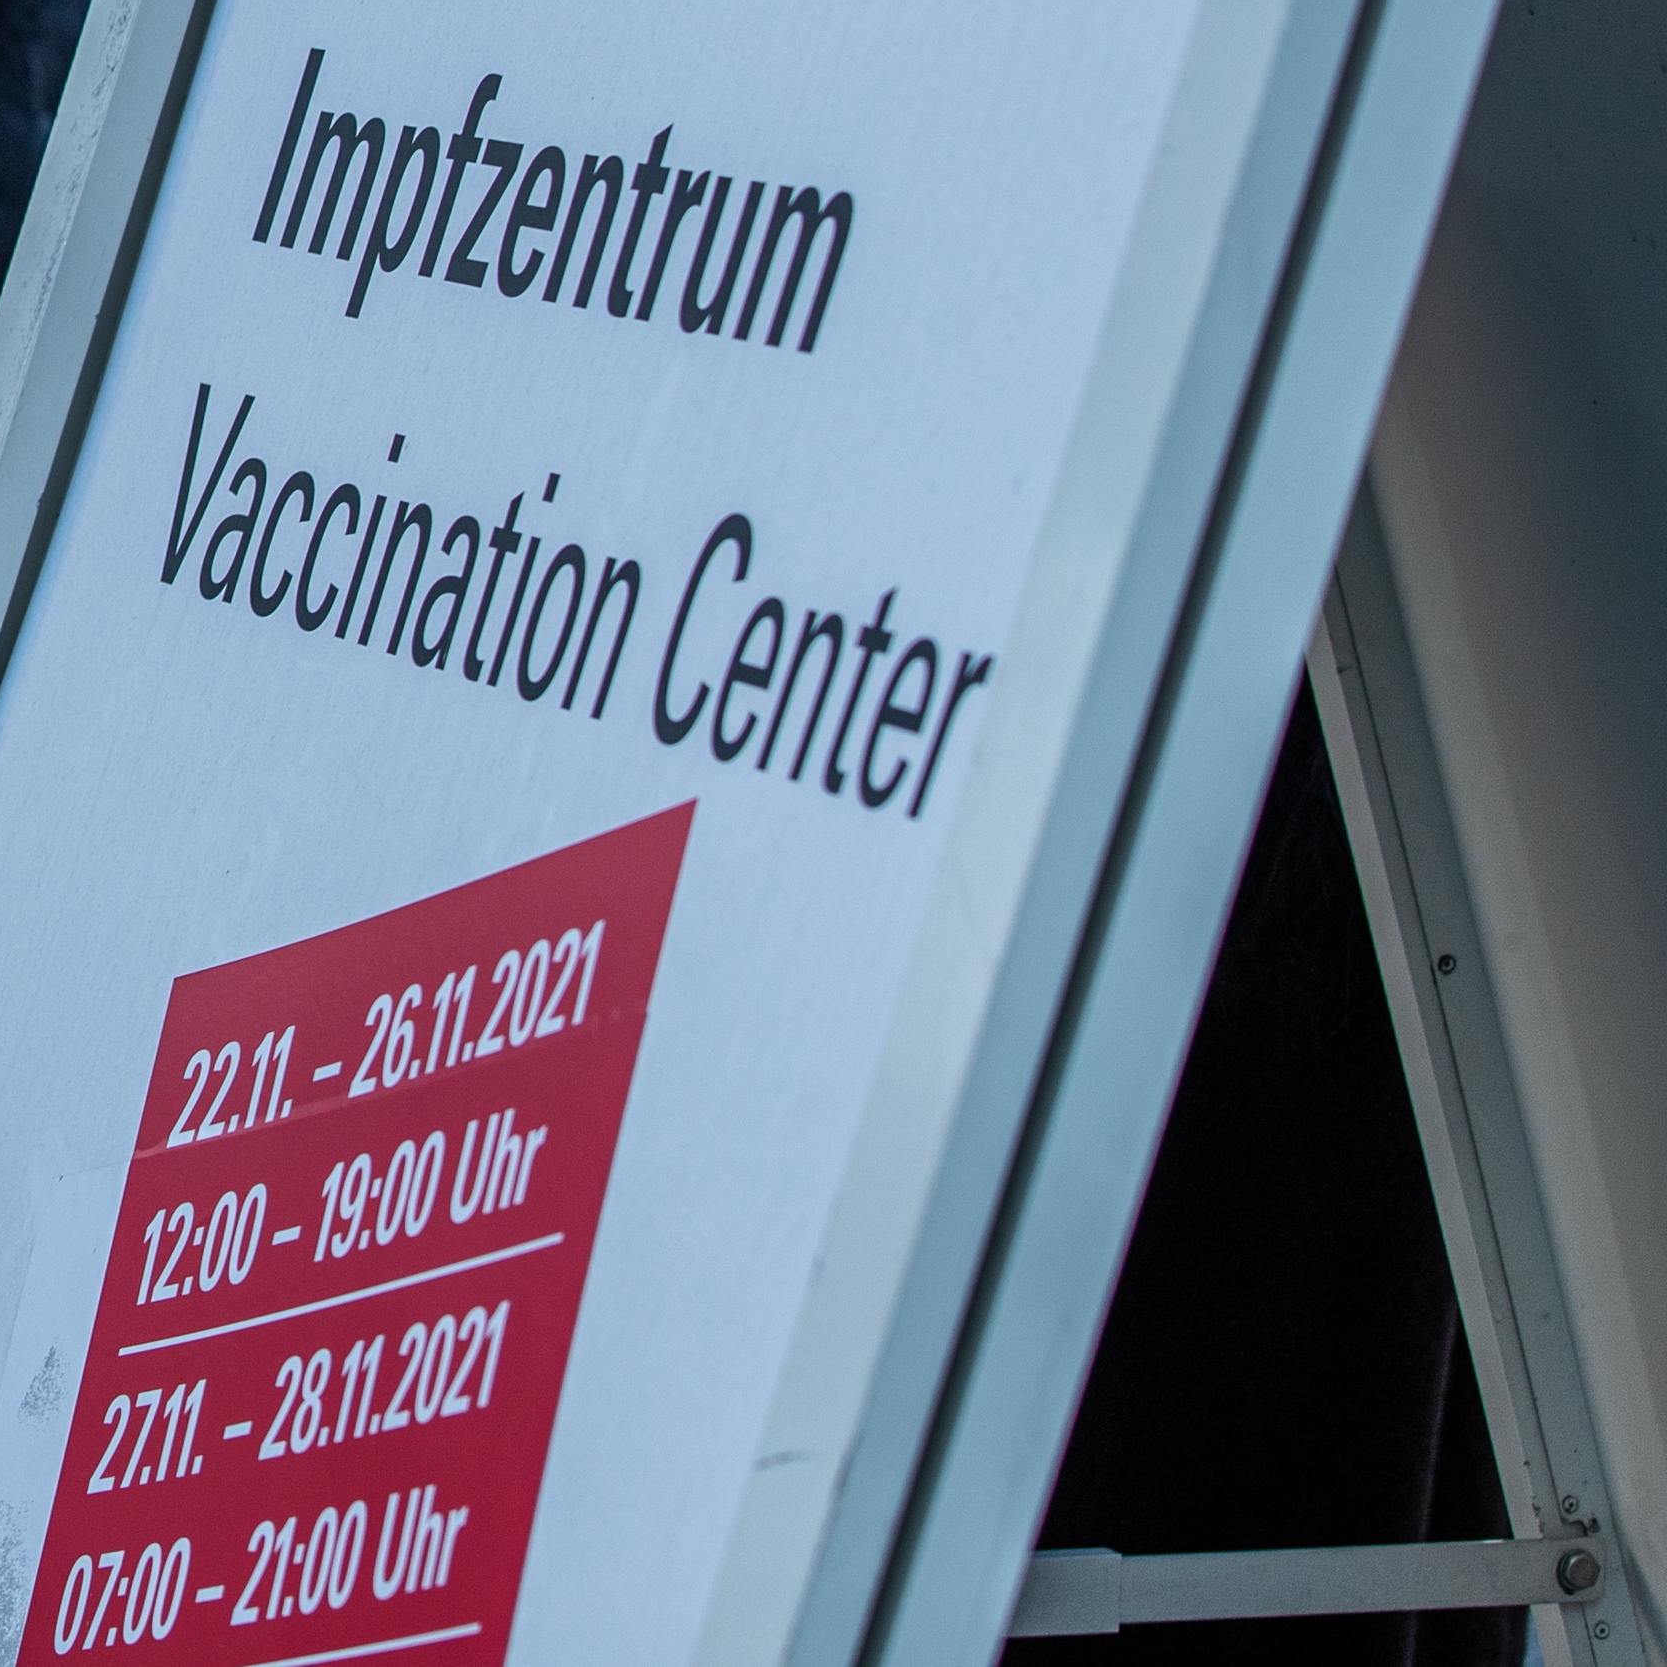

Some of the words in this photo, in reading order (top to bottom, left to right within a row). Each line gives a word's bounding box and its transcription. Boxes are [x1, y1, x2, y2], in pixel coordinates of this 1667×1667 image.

[252, 47, 855, 354] Impfzentrum
[160, 382, 642, 721] Vaccination
[653, 513, 996, 819] Center
[165, 1024, 296, 1149] 22.11.
[347, 919, 606, 1099] 26.11.2021
[136, 1182, 267, 1306] 12:00
[313, 1130, 446, 1263] 19:00
[449, 1107, 549, 1225] Uhr
[86, 1378, 207, 1495] 27.11.
[257, 1300, 511, 1461] 28.11.2021
[53, 1536, 191, 1655] 07:00
[230, 1499, 367, 1626] 21:00
[372, 1484, 470, 1601] Uhr
